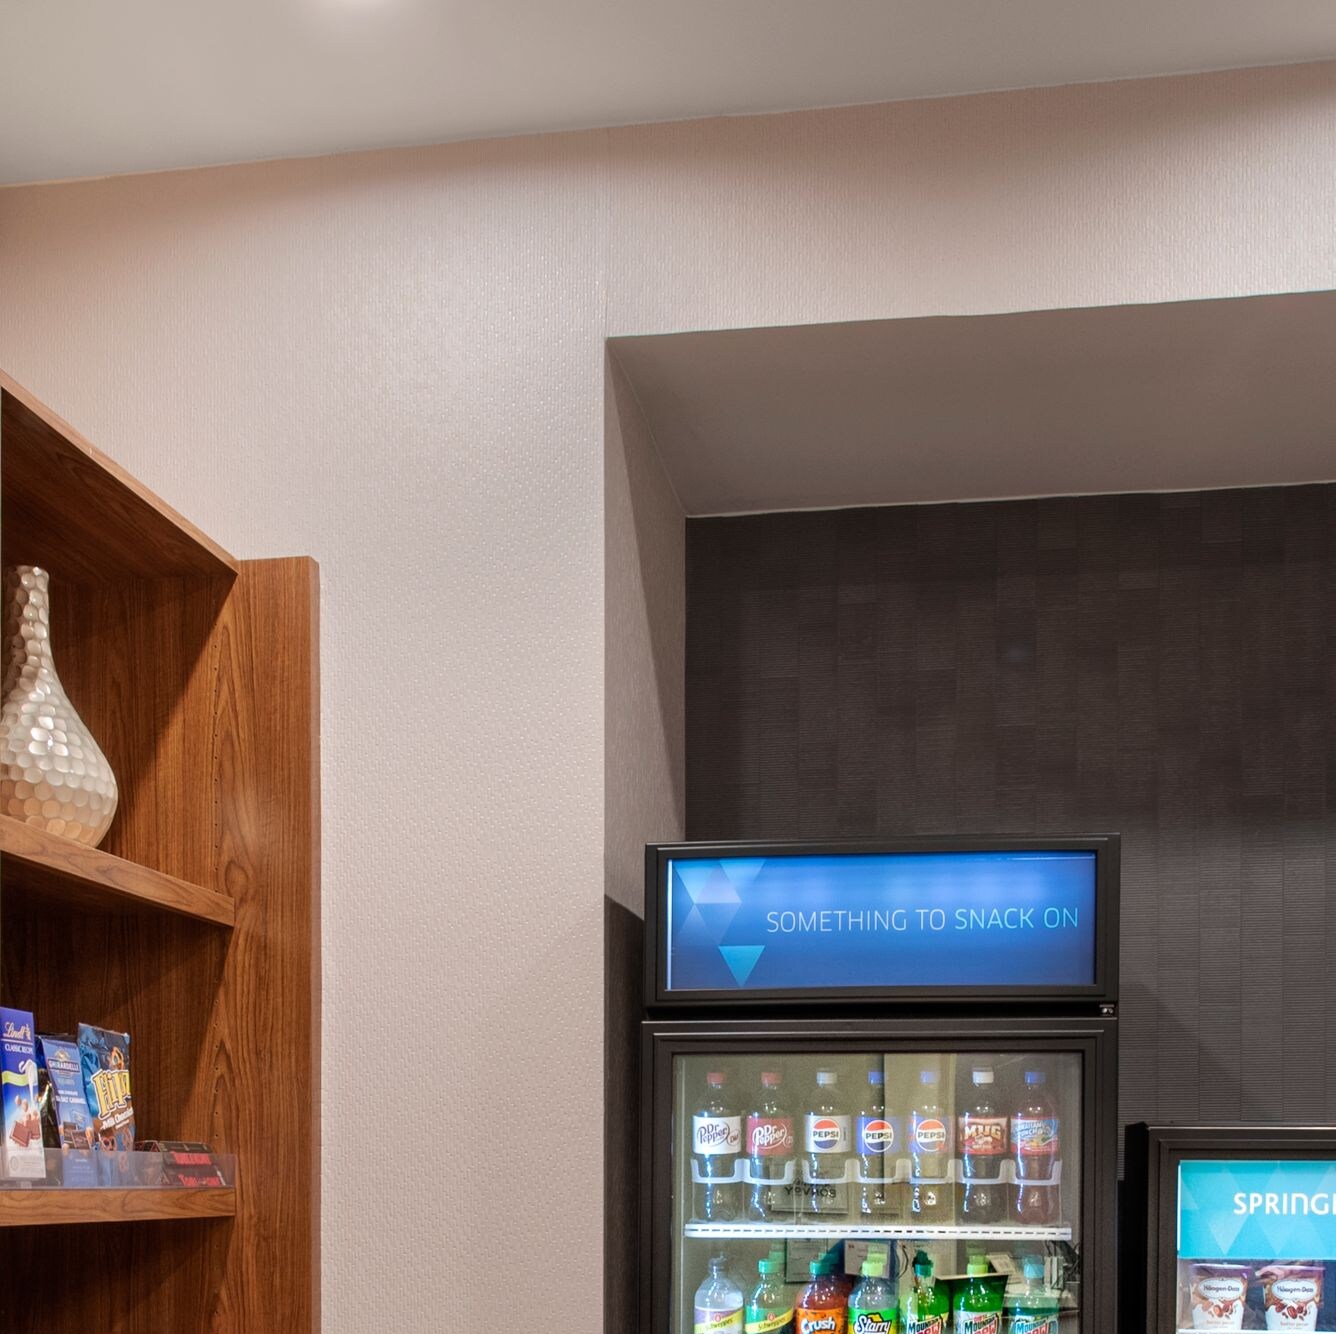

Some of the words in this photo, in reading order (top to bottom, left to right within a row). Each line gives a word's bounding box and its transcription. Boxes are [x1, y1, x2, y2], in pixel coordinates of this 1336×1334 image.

[765, 908, 908, 933] SOMETHING
[914, 907, 946, 931] TO
[953, 906, 1035, 930] SNACK
[1043, 906, 1079, 929] ON
[700, 1124, 729, 1144] Pepper
[706, 1123, 720, 1133] Dr
[754, 1125, 785, 1146] Pepper
[813, 1130, 839, 1138] PEPSI
[866, 1130, 893, 1140] PEPSI
[917, 1130, 945, 1140] PEPSI
[964, 1124, 1001, 1141] MUG
[801, 1316, 836, 1334] Crush
